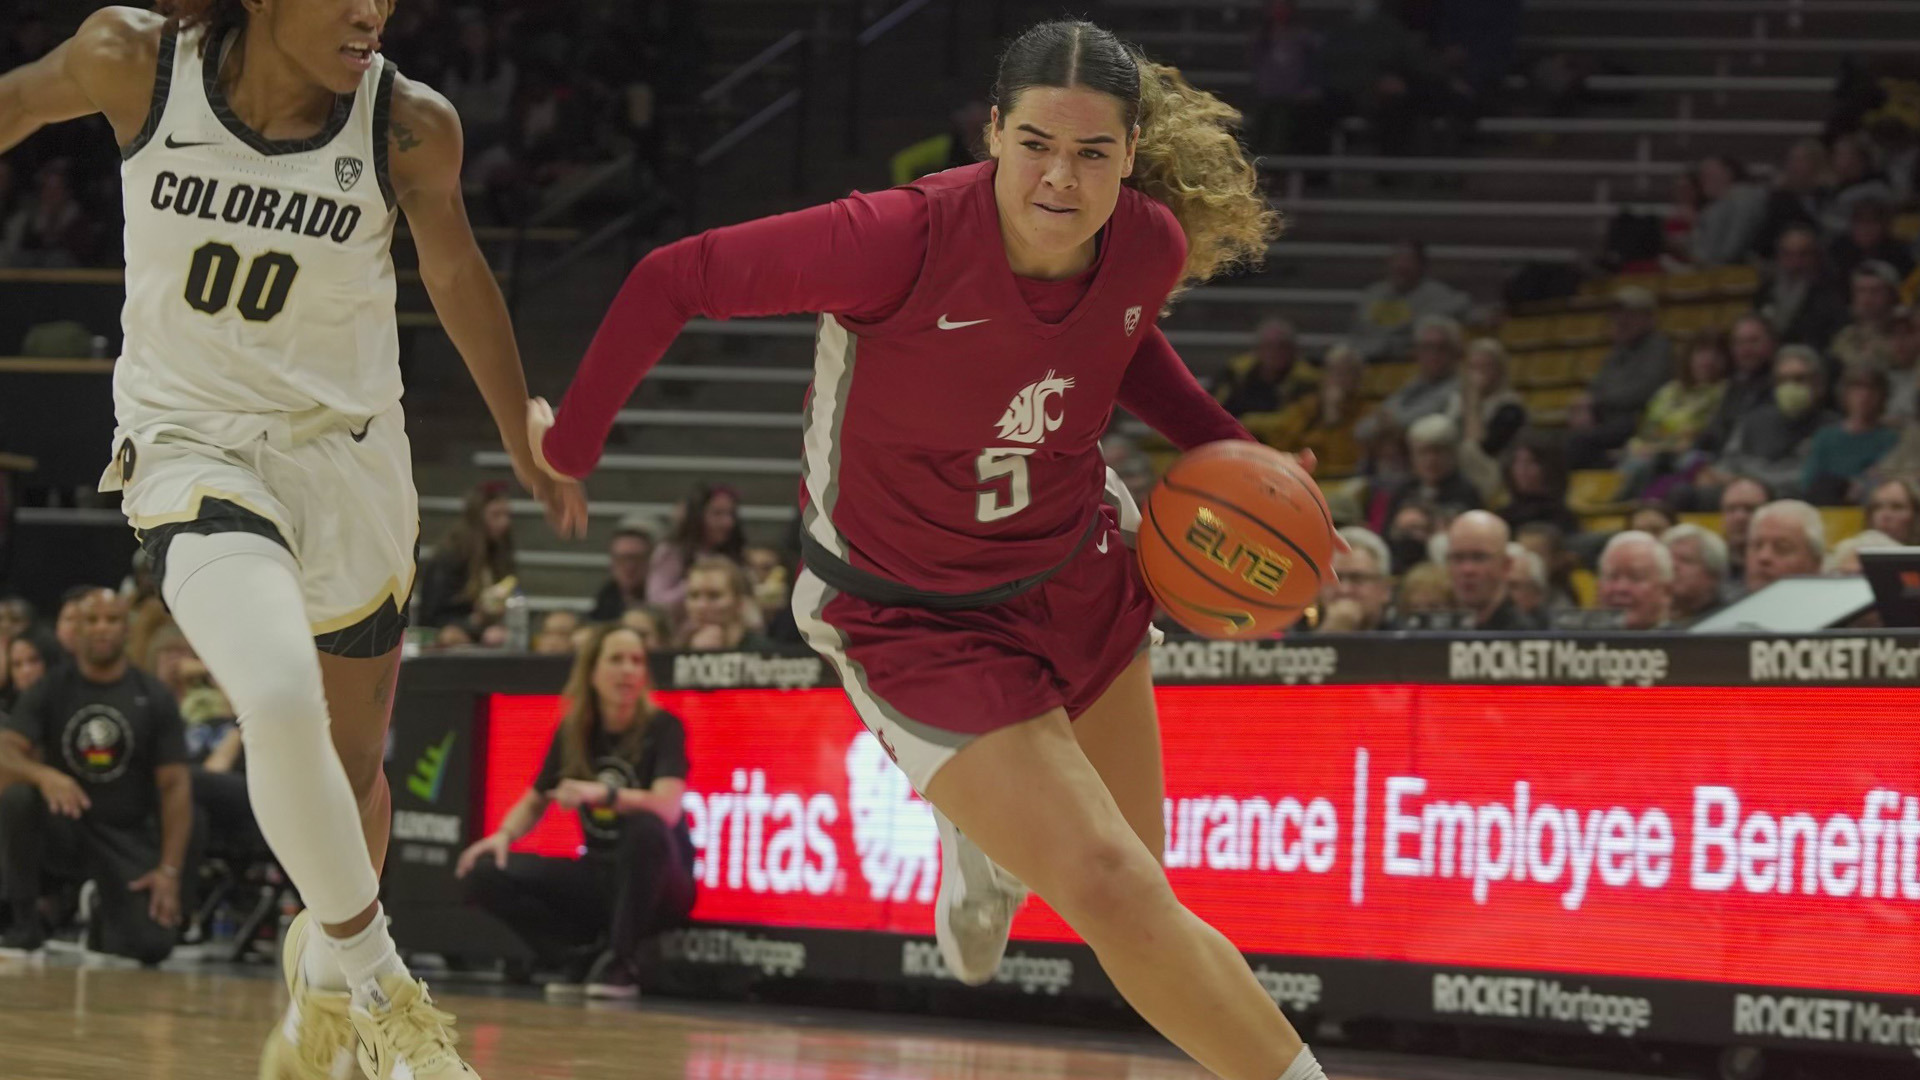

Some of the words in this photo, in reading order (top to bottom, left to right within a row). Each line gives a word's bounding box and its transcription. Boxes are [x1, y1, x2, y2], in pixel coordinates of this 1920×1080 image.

[151, 170, 362, 243] COLORADO
[184, 241, 299, 322] 00
[975, 447, 1036, 523] 5
[1185, 507, 1292, 597] ELITE
[1237, 641, 1336, 685] Mortgage
[1450, 640, 1551, 680] ROCKET
[1552, 640, 1667, 687] Mortgage
[1750, 638, 1867, 681] ROCKET
[1383, 776, 1674, 911] Employee
[1433, 974, 1535, 1017] ROCKET
[1535, 979, 1651, 1036] Mortgage
[1734, 994, 1851, 1041] ROCKET
